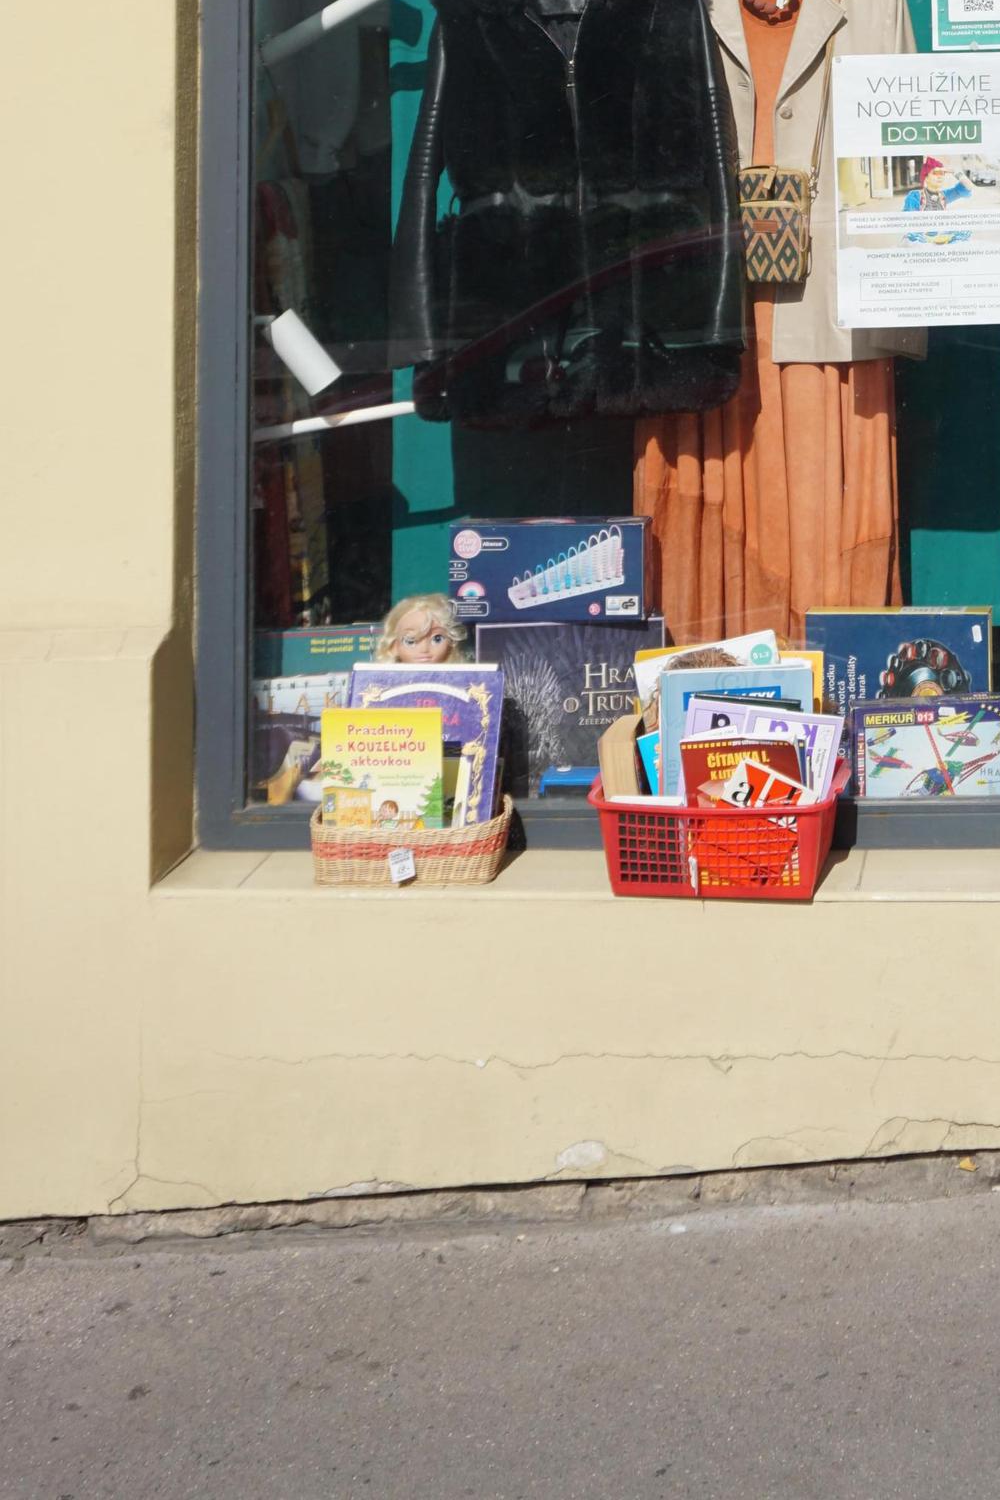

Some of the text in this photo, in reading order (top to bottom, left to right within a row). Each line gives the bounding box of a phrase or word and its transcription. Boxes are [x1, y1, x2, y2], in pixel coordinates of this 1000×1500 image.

[866, 71, 992, 94] VYHLÍŽÍME
[857, 96, 922, 118] NOVÉ
[887, 122, 977, 142] DO TÝMU
[847, 655, 857, 694] destiláty
[581, 690, 635, 716] TRŮN
[865, 714, 914, 725] MERKUR
[917, 712, 934, 722] 013
[348, 741, 426, 752] KOUZELNOU
[350, 756, 411, 767] aktovkou
[707, 751, 760, 768] ČÍTANKA
